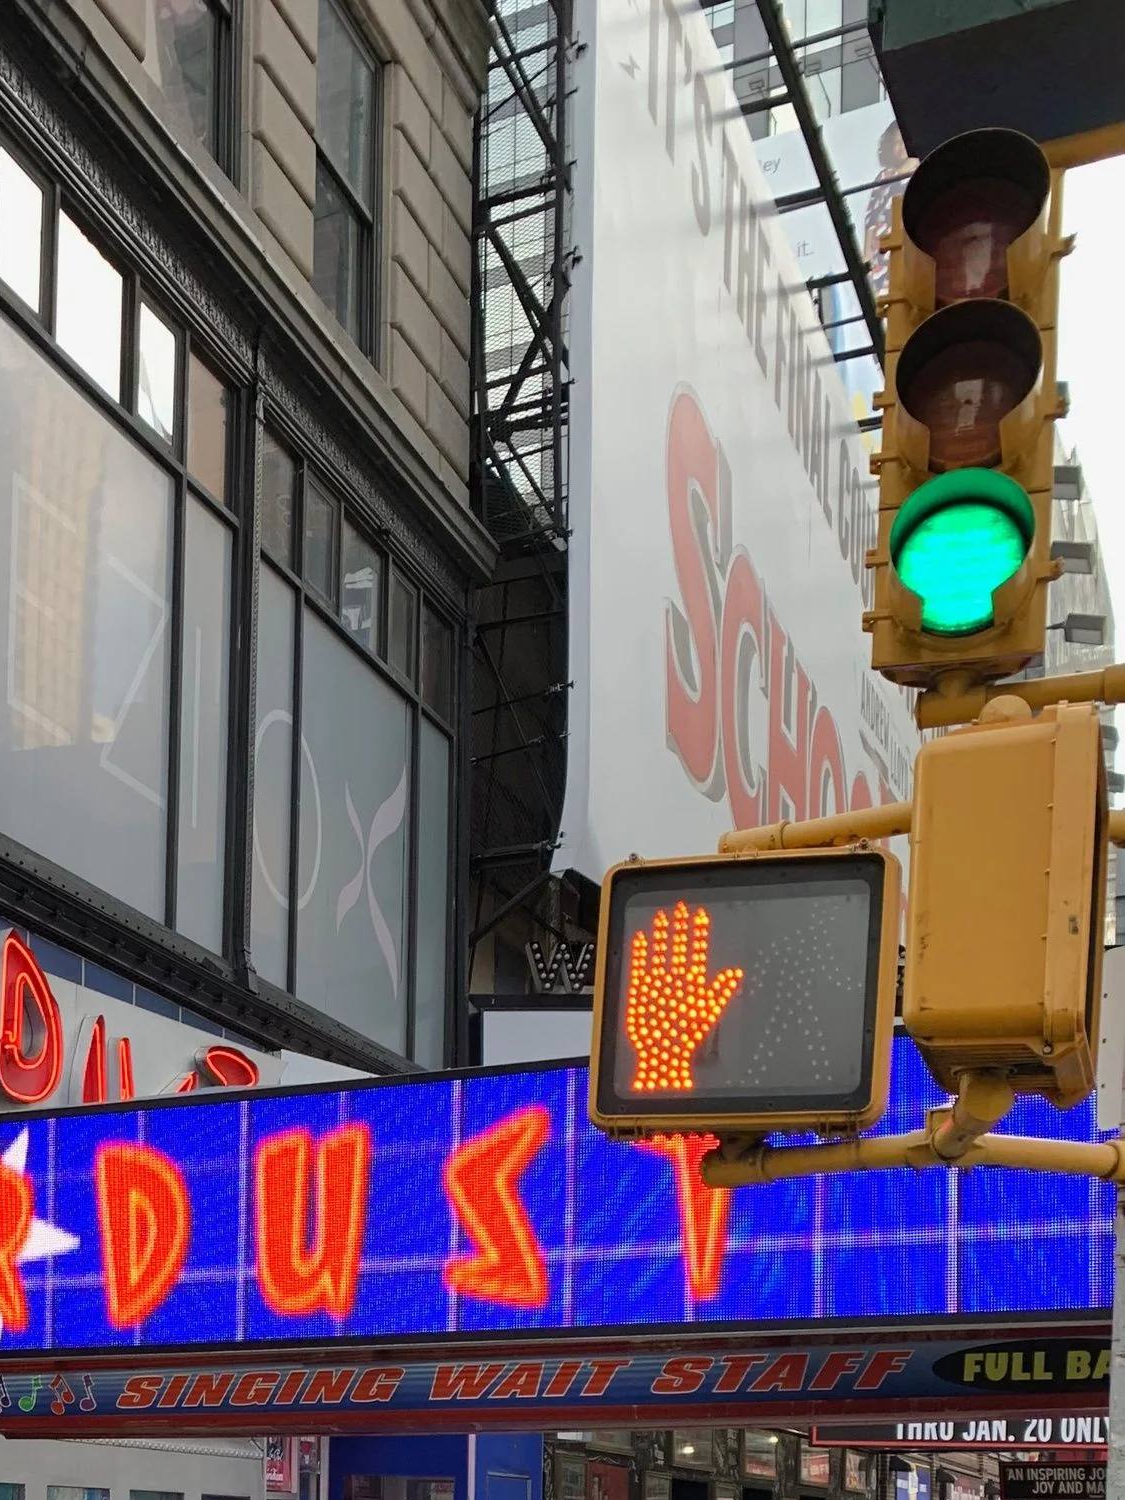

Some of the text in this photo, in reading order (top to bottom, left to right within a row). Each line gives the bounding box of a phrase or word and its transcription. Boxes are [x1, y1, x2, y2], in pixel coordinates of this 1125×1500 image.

[722, 123, 772, 379] THE
[774, 268, 833, 530] FINAL
[116, 1349, 916, 1409] SINGING WAIT STAFF
[963, 1352, 1053, 1382] FULL
[962, 1419, 1016, 1442] JAN.
[1024, 1418, 1053, 1442] 20
[1027, 1467, 1086, 1481] INSPIRING
[1032, 1481, 1055, 1494] JOY
[1058, 1481, 1084, 1495] AND
